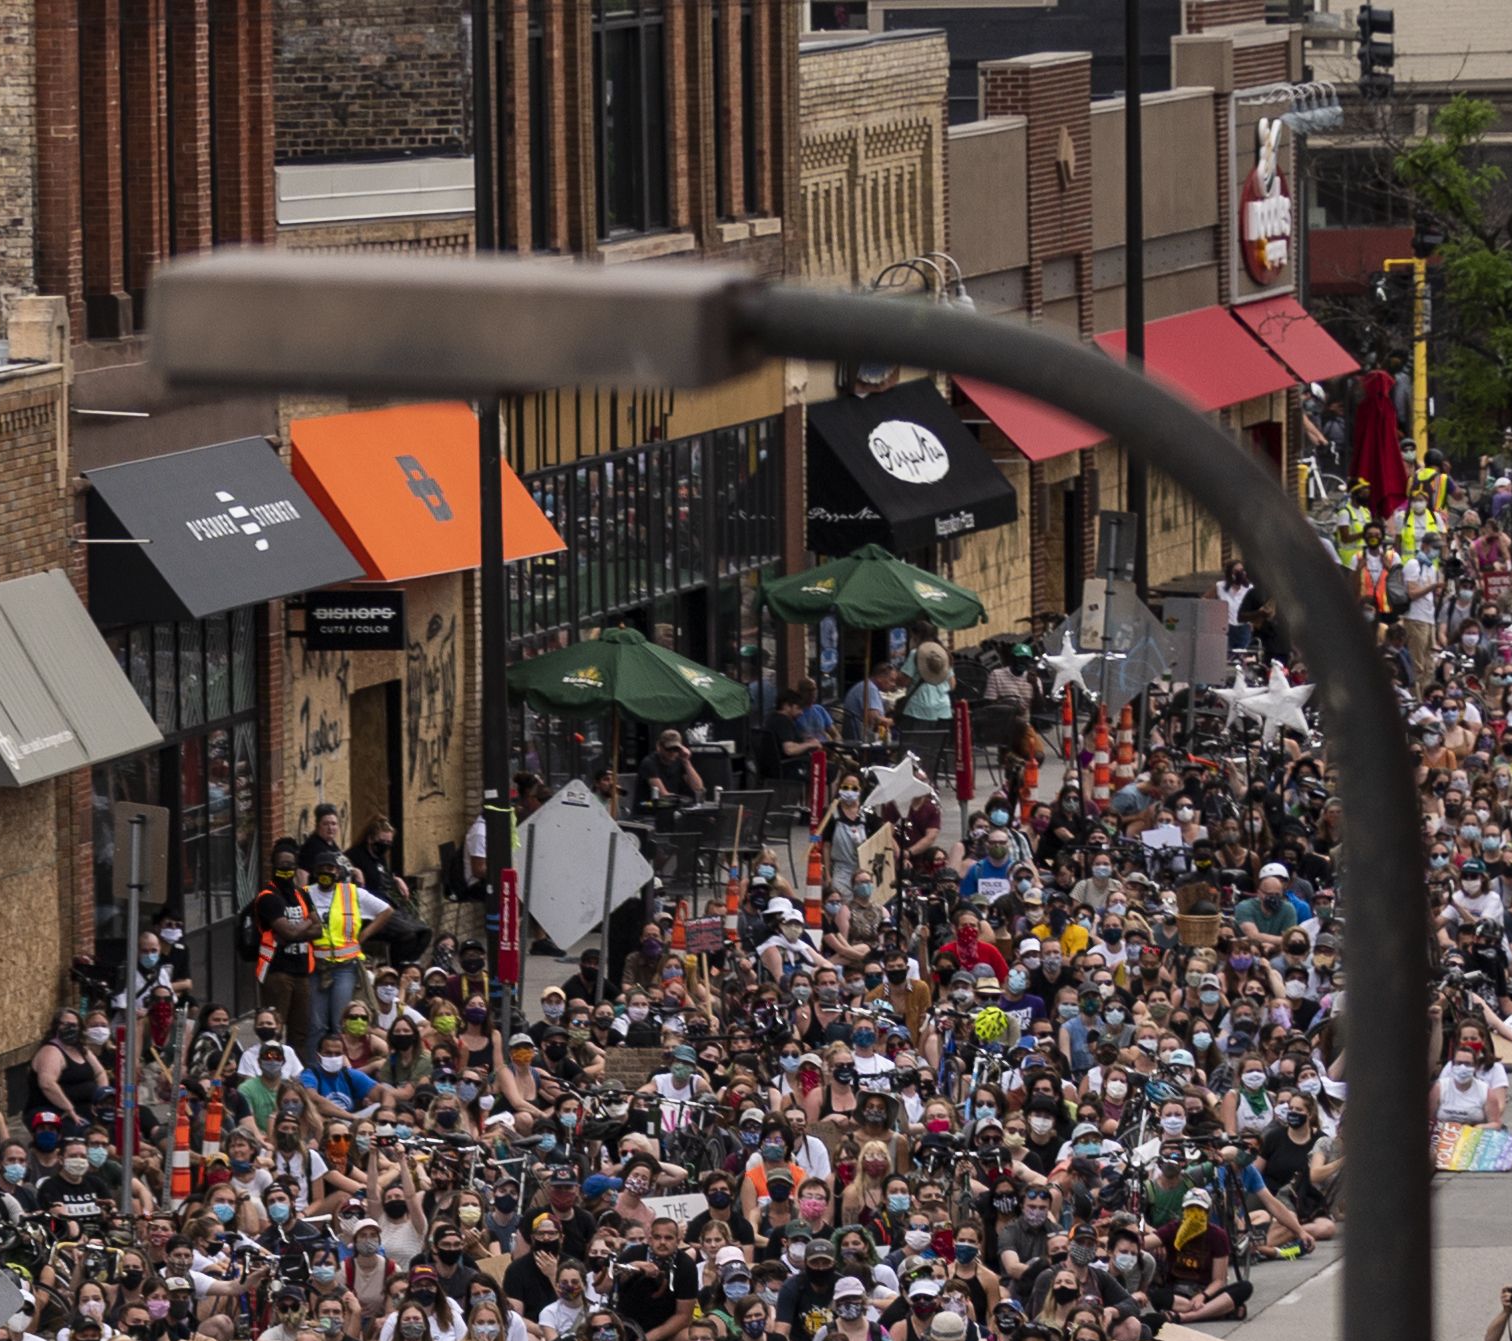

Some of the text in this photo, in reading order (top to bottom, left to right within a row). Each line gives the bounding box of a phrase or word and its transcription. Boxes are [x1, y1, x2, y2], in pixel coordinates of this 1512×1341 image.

[313, 607, 394, 620] BISHOPS
[319, 625, 347, 634] CUTS
[356, 625, 390, 634] COLOR
[63, 1193, 98, 1203] BLACK
[66, 1204, 98, 1214] LIVES
[662, 1202, 692, 1220] THE
